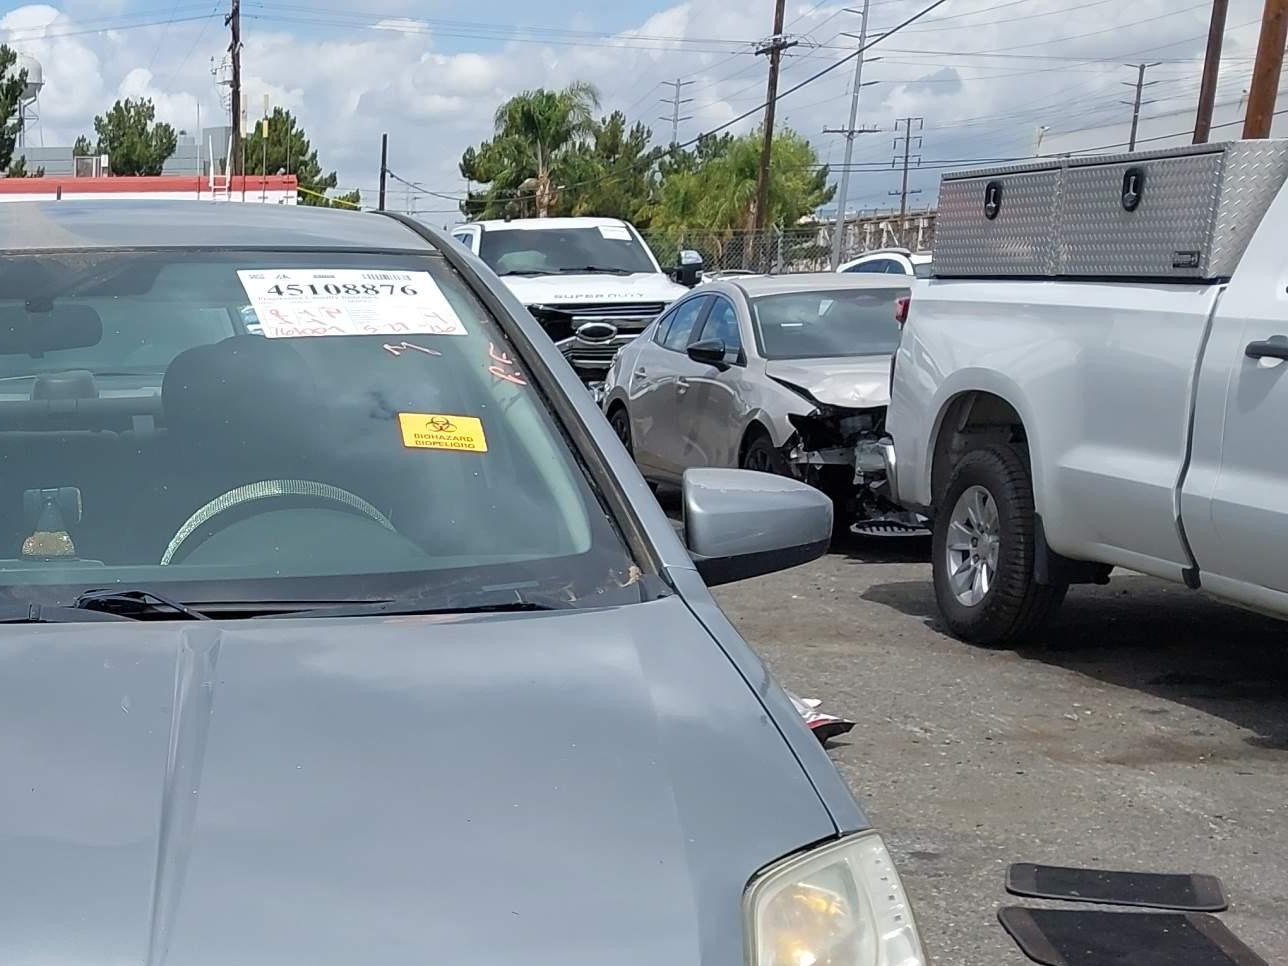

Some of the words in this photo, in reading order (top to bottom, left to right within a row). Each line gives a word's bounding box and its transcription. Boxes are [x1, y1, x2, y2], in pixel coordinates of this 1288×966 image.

[267, 283, 418, 296] 45108876
[413, 432, 474, 443] BIOHAZARD
[415, 440, 476, 449] BIOPELIGRO
